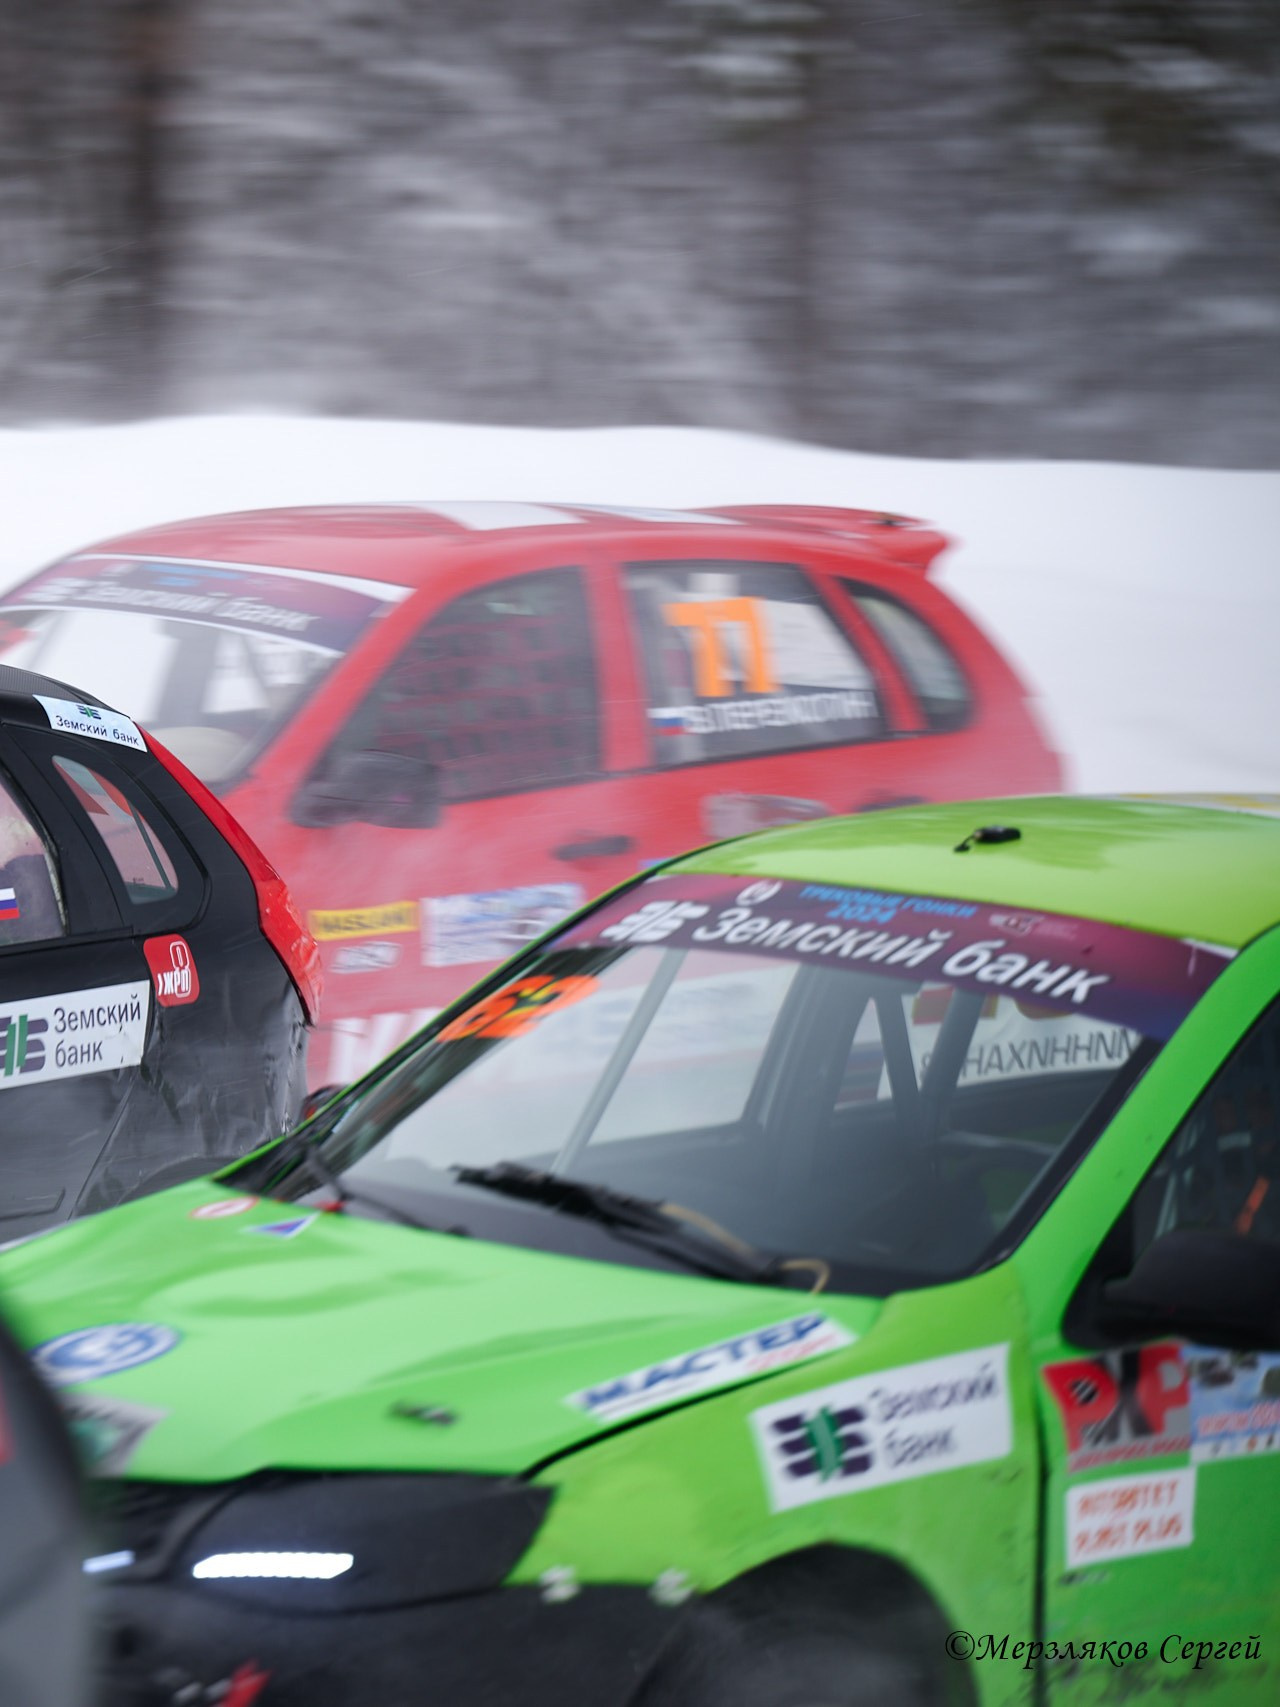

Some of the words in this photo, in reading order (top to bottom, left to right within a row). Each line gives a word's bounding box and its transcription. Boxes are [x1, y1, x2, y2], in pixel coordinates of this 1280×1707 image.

[55, 714, 108, 739] Земский
[113, 726, 140, 747] банк
[691, 906, 954, 969] Земский
[942, 939, 1110, 1004] банк
[53, 993, 142, 1033] Земский
[54, 1040, 104, 1068] банк
[583, 1312, 830, 1410] МАСТЕР
[868, 1362, 999, 1424] Земский
[884, 1428, 960, 1468] банк
